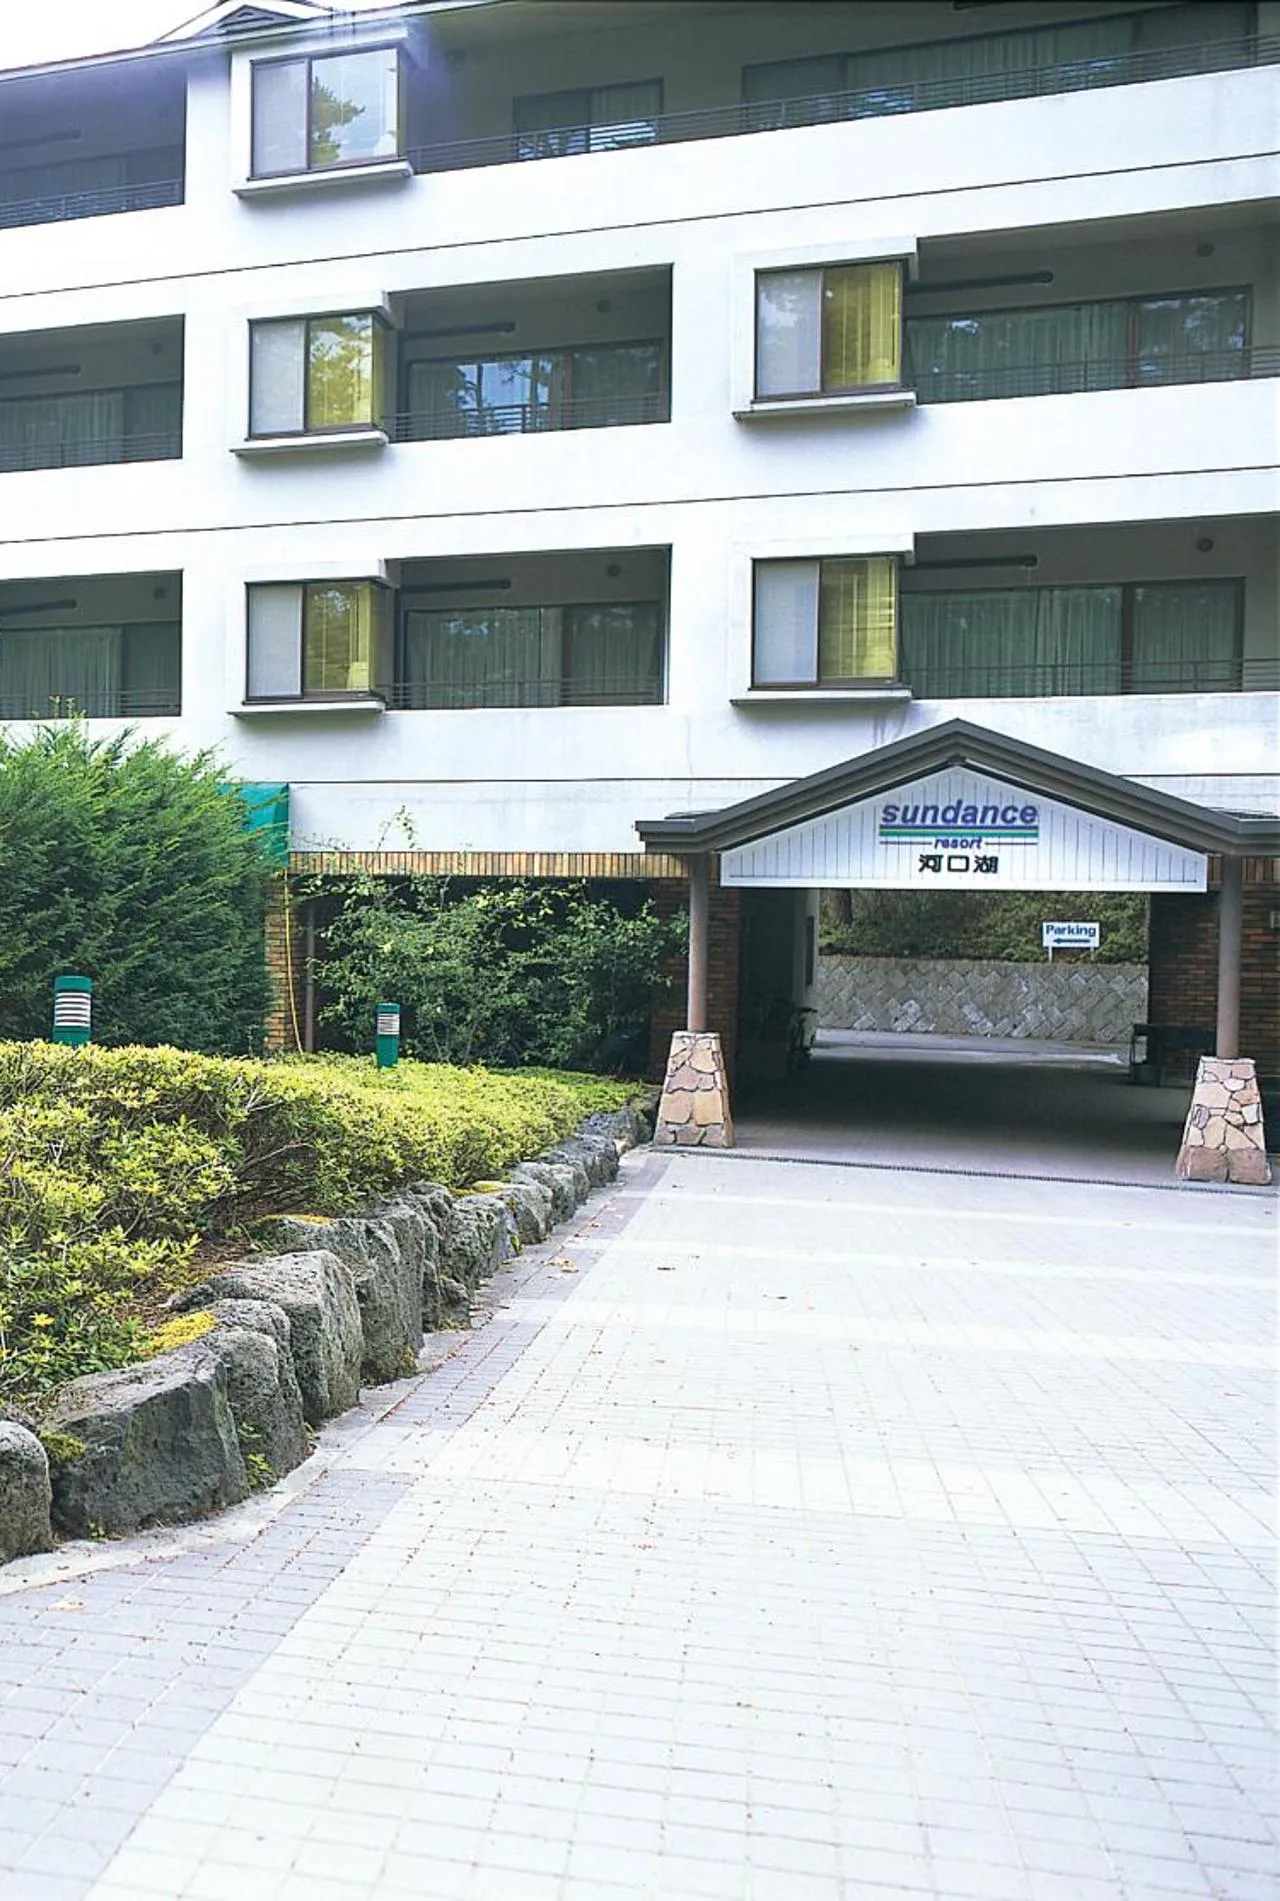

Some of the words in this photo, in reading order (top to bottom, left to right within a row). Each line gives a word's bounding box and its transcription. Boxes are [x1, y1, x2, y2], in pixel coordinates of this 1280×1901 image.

[881, 798, 1039, 824] sundance
[934, 837, 983, 849] resort
[918, 854, 999, 874] 河口湖
[1045, 924, 1097, 938] Parking
